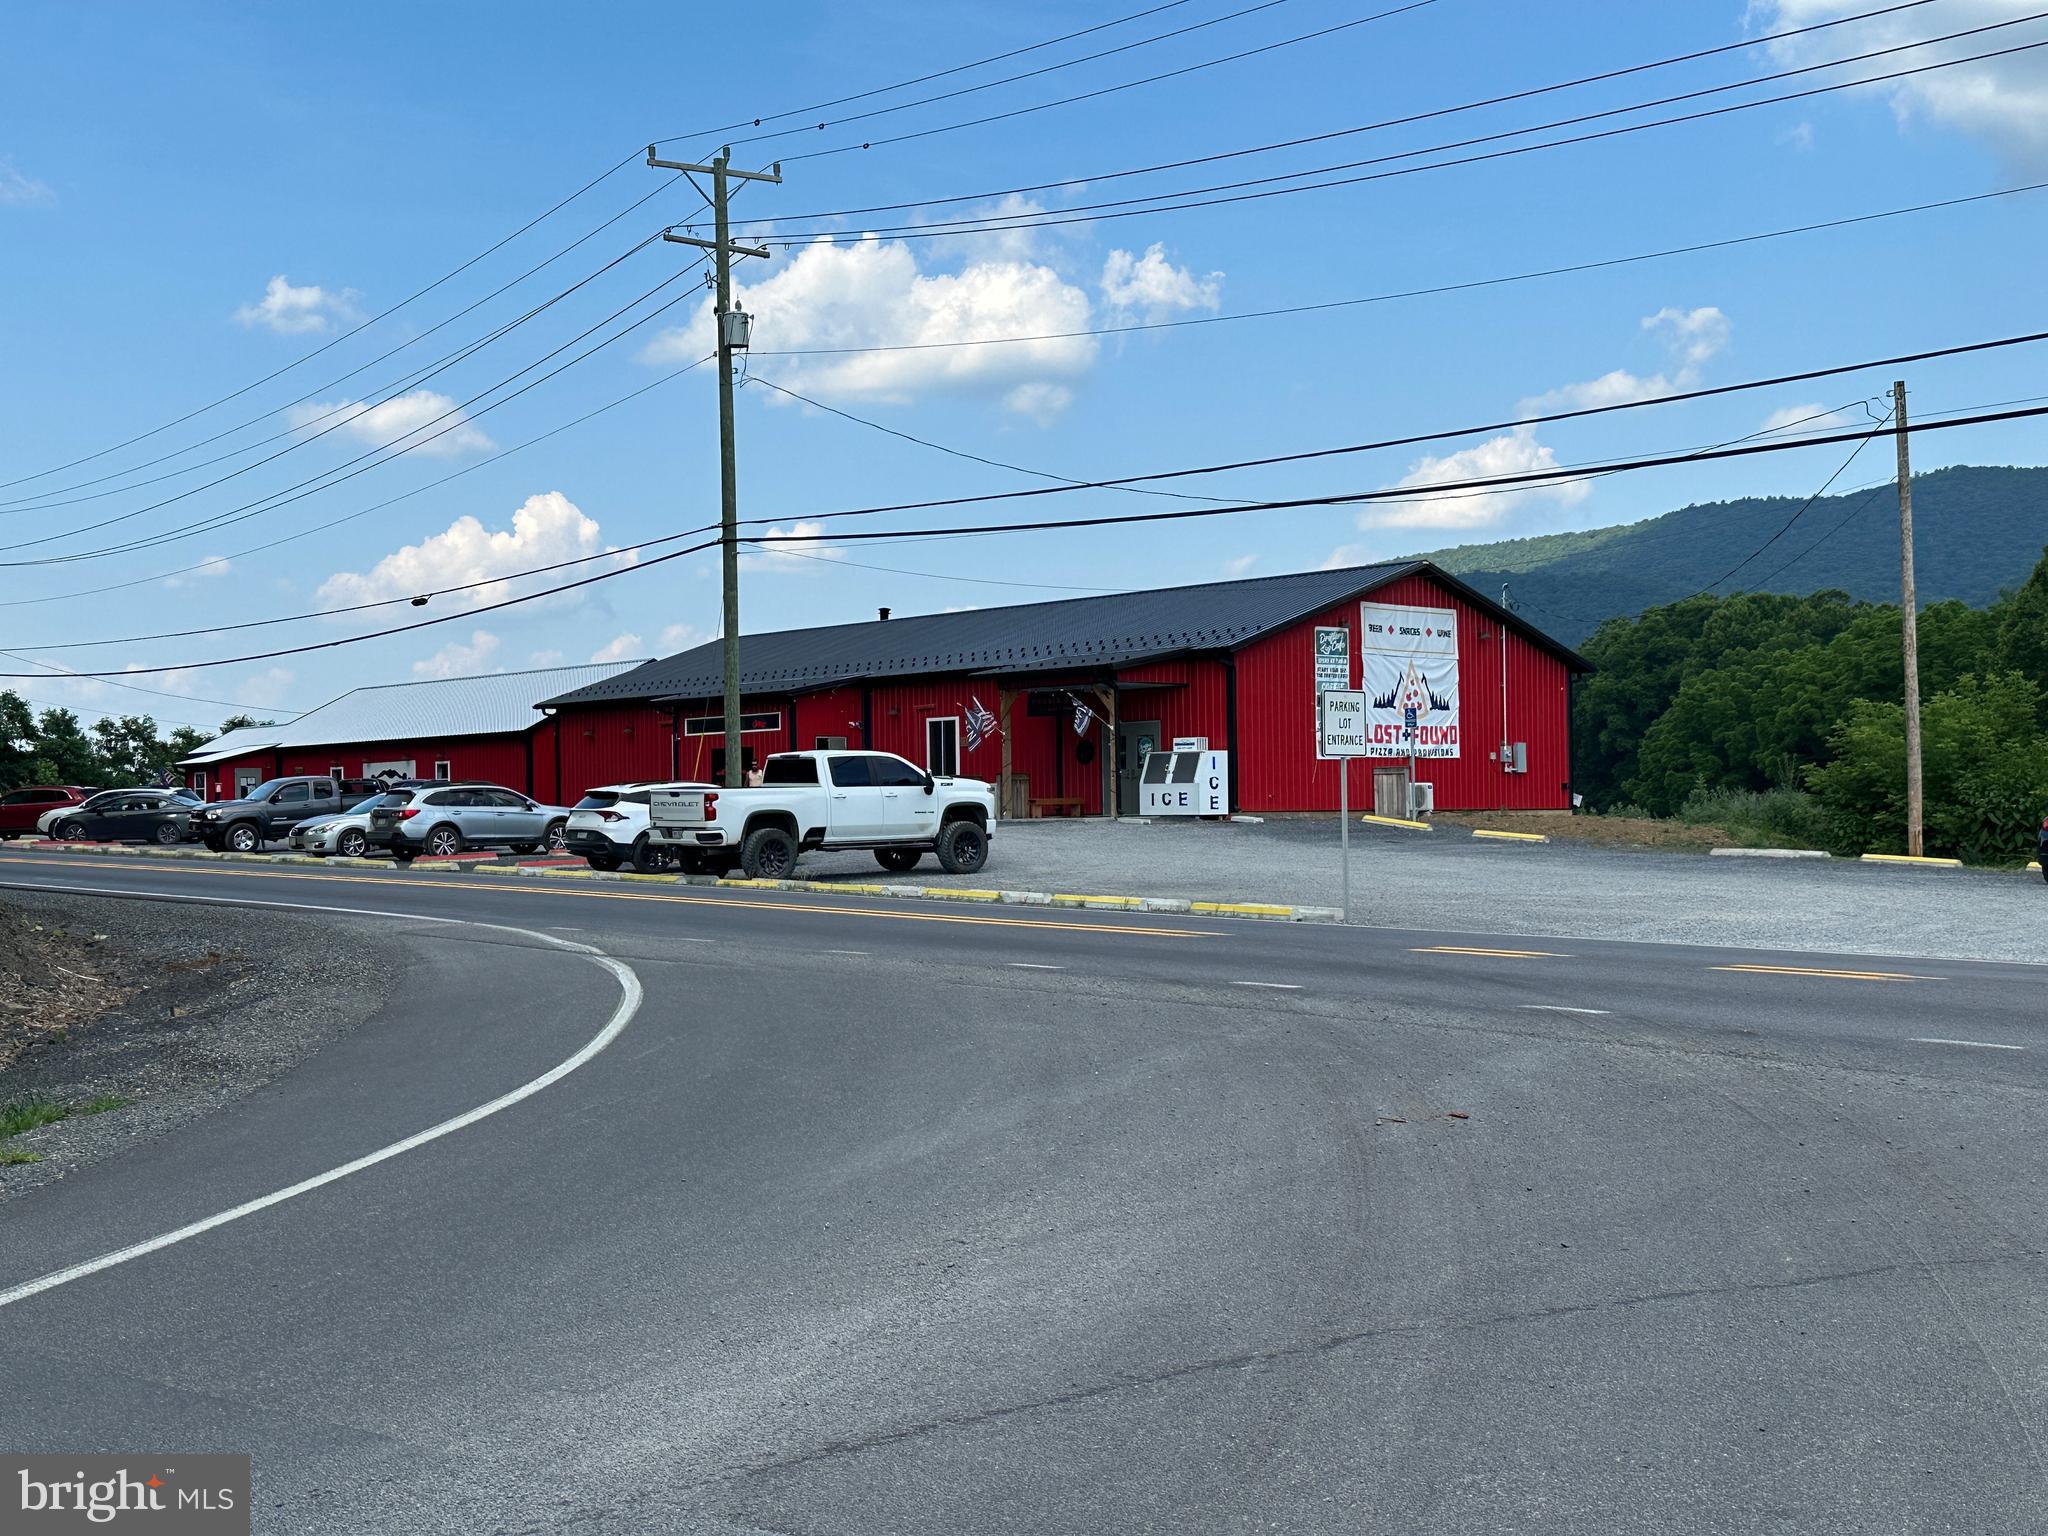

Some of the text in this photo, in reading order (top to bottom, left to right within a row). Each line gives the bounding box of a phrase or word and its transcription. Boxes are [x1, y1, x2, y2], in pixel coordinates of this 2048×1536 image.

[1368, 624, 1383, 633] BEER
[1399, 627, 1420, 636] SNACKS
[1329, 700, 1360, 713] PARKING
[1338, 717, 1352, 729] LOT
[1327, 734, 1364, 746] ENTRANCE
[1366, 723, 1402, 745] LOST
[1370, 747, 1393, 757] PIZZA
[1209, 756, 1220, 810] ICE
[1151, 792, 1189, 807] ICE
